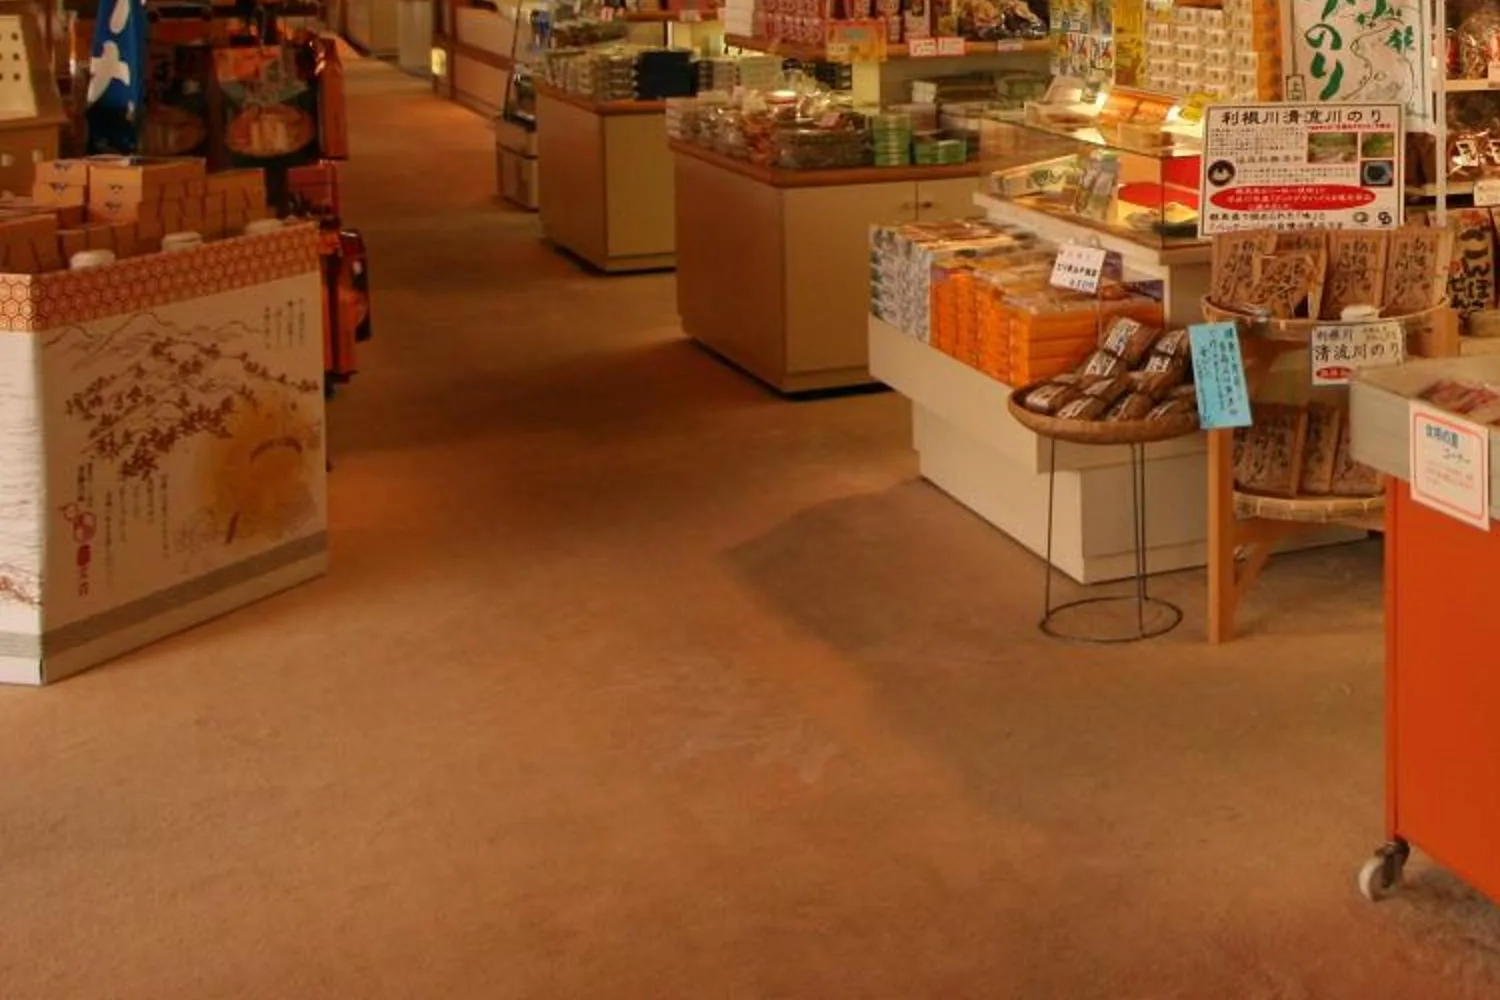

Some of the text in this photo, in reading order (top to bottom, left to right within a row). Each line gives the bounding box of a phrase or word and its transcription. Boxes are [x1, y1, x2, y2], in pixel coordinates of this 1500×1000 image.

[1220, 108, 1383, 127] 利根川清流川のり
